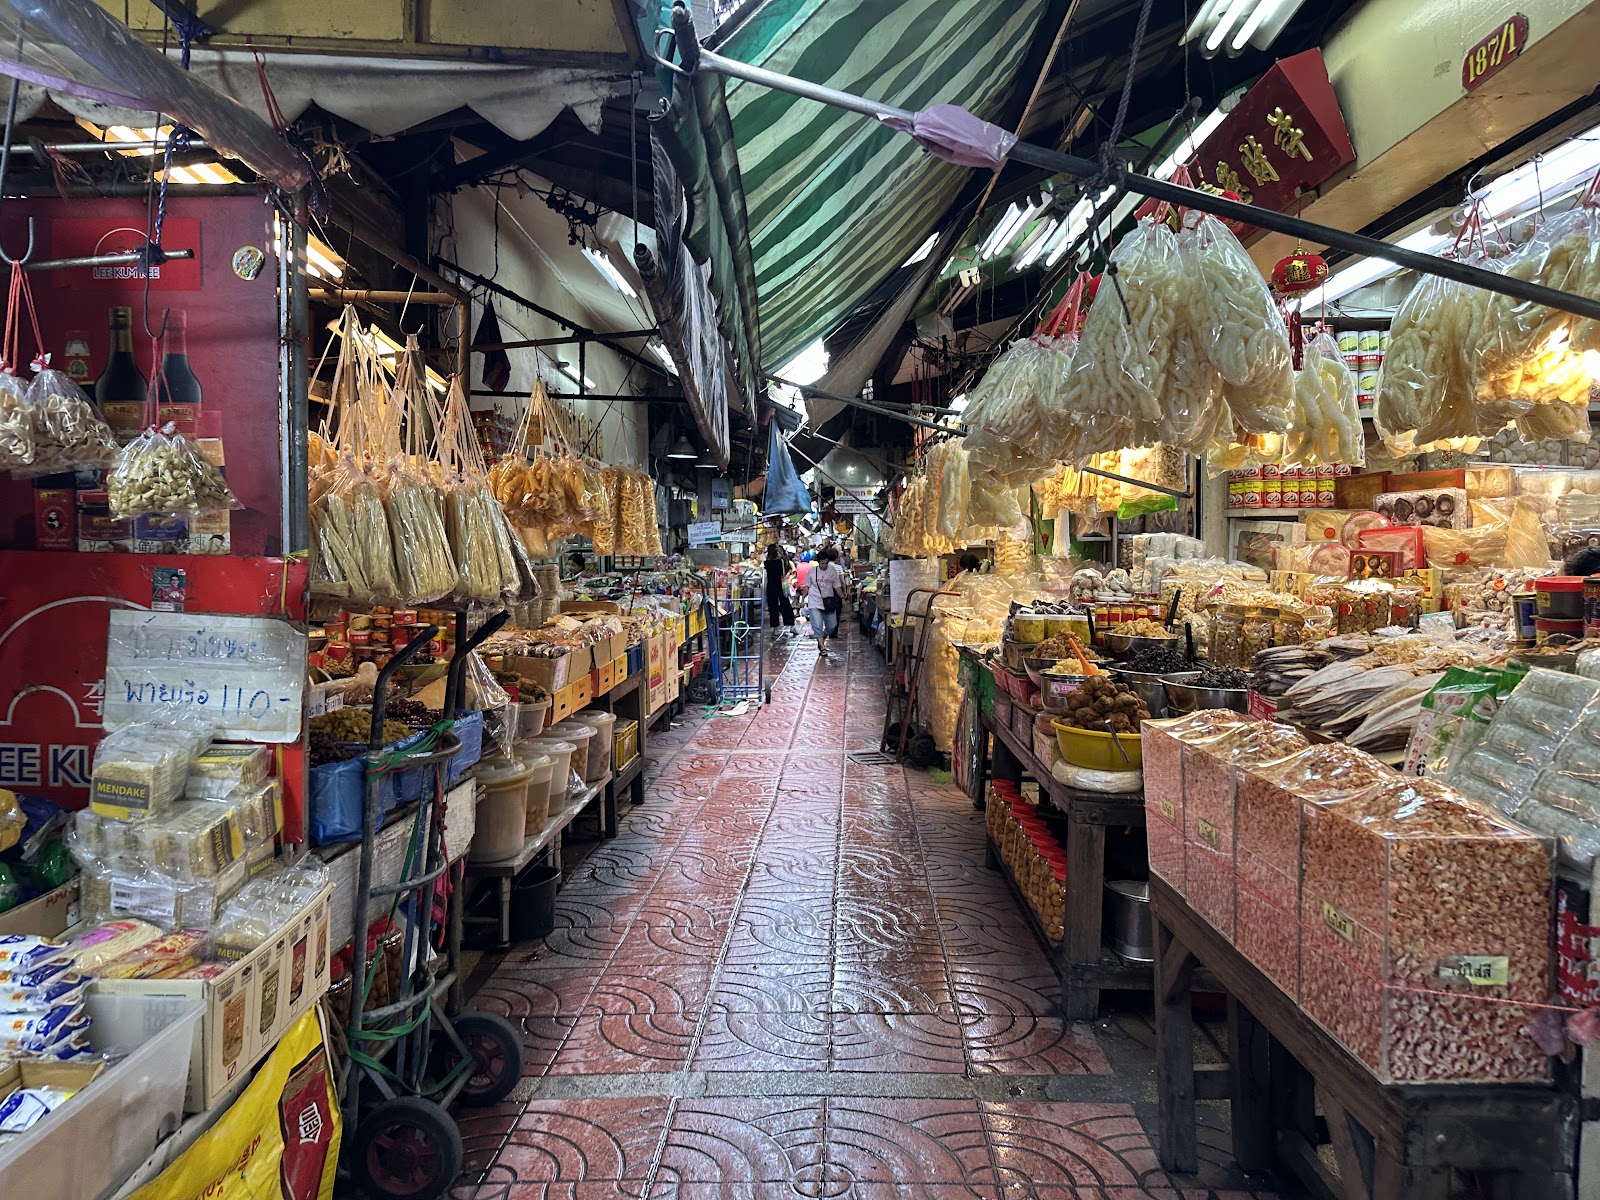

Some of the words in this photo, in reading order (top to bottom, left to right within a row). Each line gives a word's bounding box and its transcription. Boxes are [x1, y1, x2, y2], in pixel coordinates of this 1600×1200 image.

[1468, 22, 1517, 83] 187/1
[93, 267, 112, 279] LEE
[96, 783, 146, 799] MENDAKE
[214, 825, 227, 868] MENDAKE
